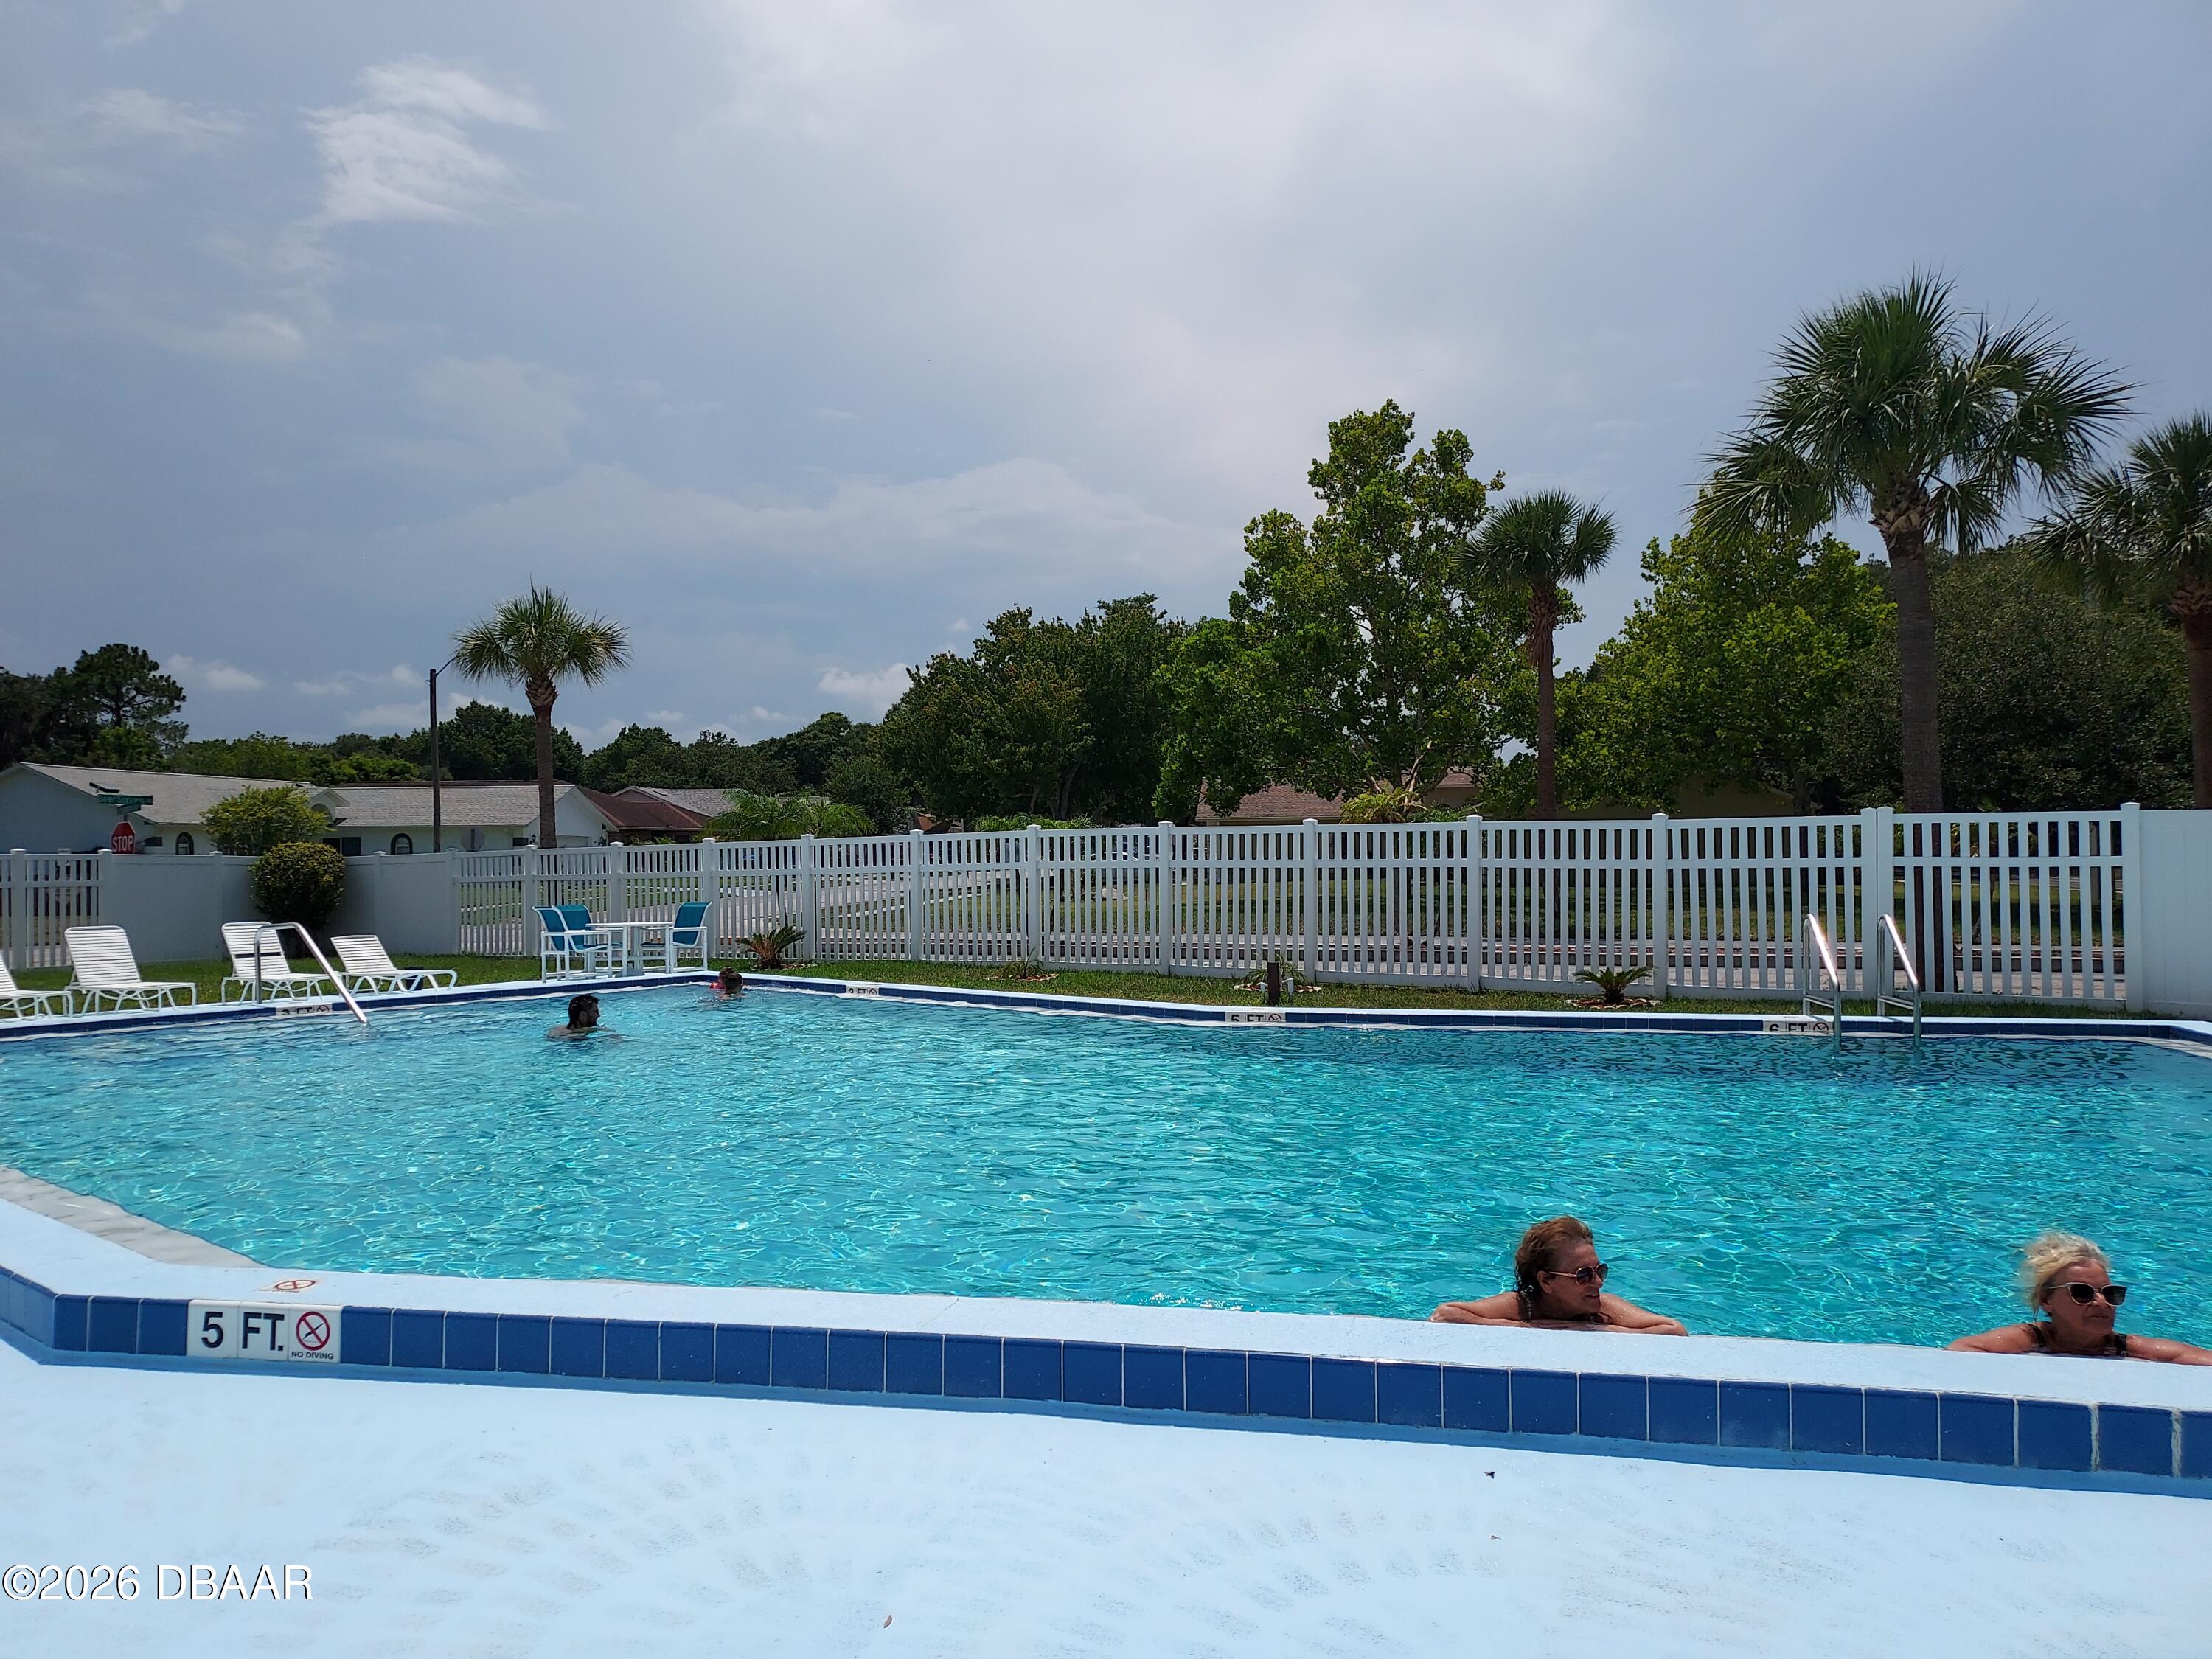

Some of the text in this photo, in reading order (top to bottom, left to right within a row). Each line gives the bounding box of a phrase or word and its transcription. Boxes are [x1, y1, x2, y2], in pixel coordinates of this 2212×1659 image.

[113, 835, 133, 852] STOP
[201, 1312, 285, 1351] 5 FT.
[305, 1352, 333, 1360] DIVING
